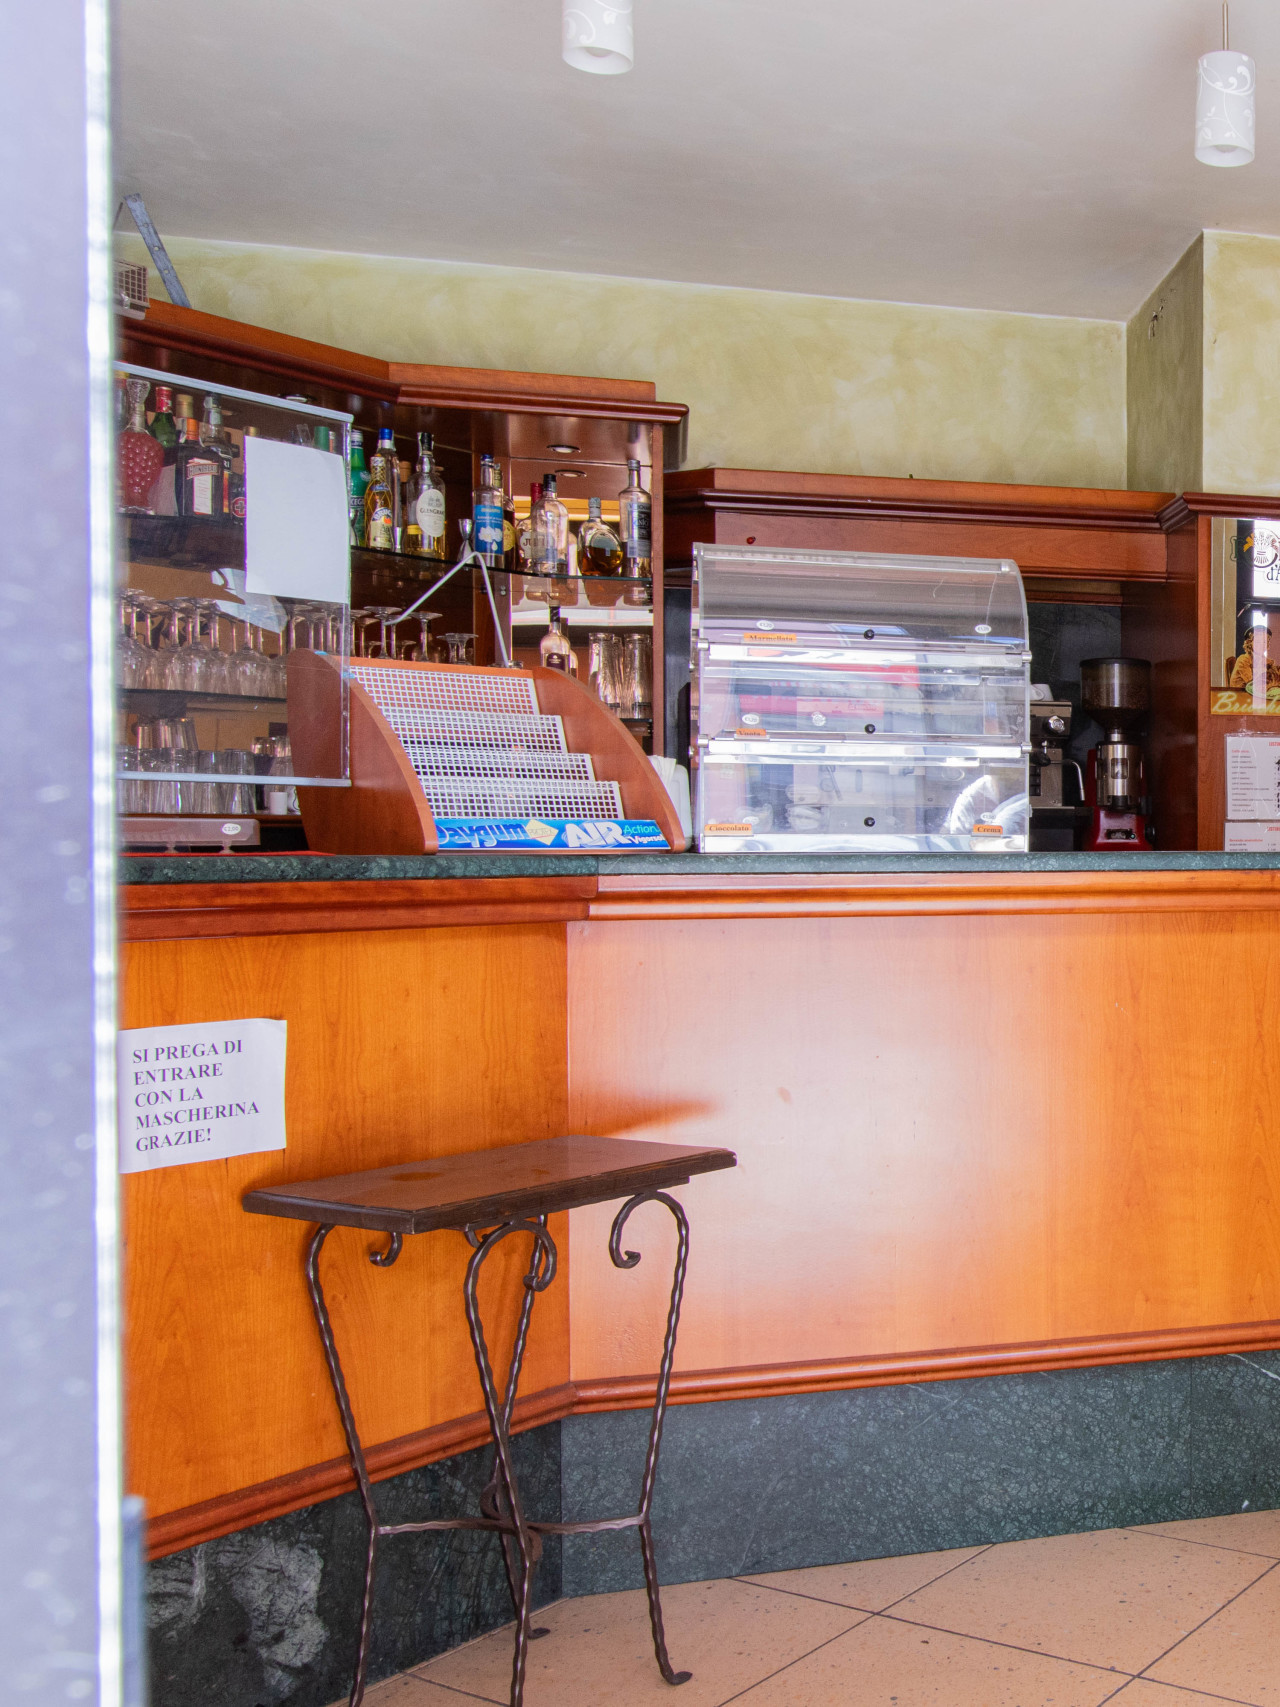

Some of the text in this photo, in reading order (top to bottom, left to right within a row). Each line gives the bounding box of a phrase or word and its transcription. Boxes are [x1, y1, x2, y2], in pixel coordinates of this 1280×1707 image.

[565, 821, 632, 848] AIR
[132, 1039, 243, 1064] SI PREGA DI
[134, 1063, 223, 1086] ENTRARE
[135, 1087, 204, 1108] CON LA
[136, 1101, 260, 1130] MASCHERINA
[135, 1127, 212, 1152] GRAZIE!
